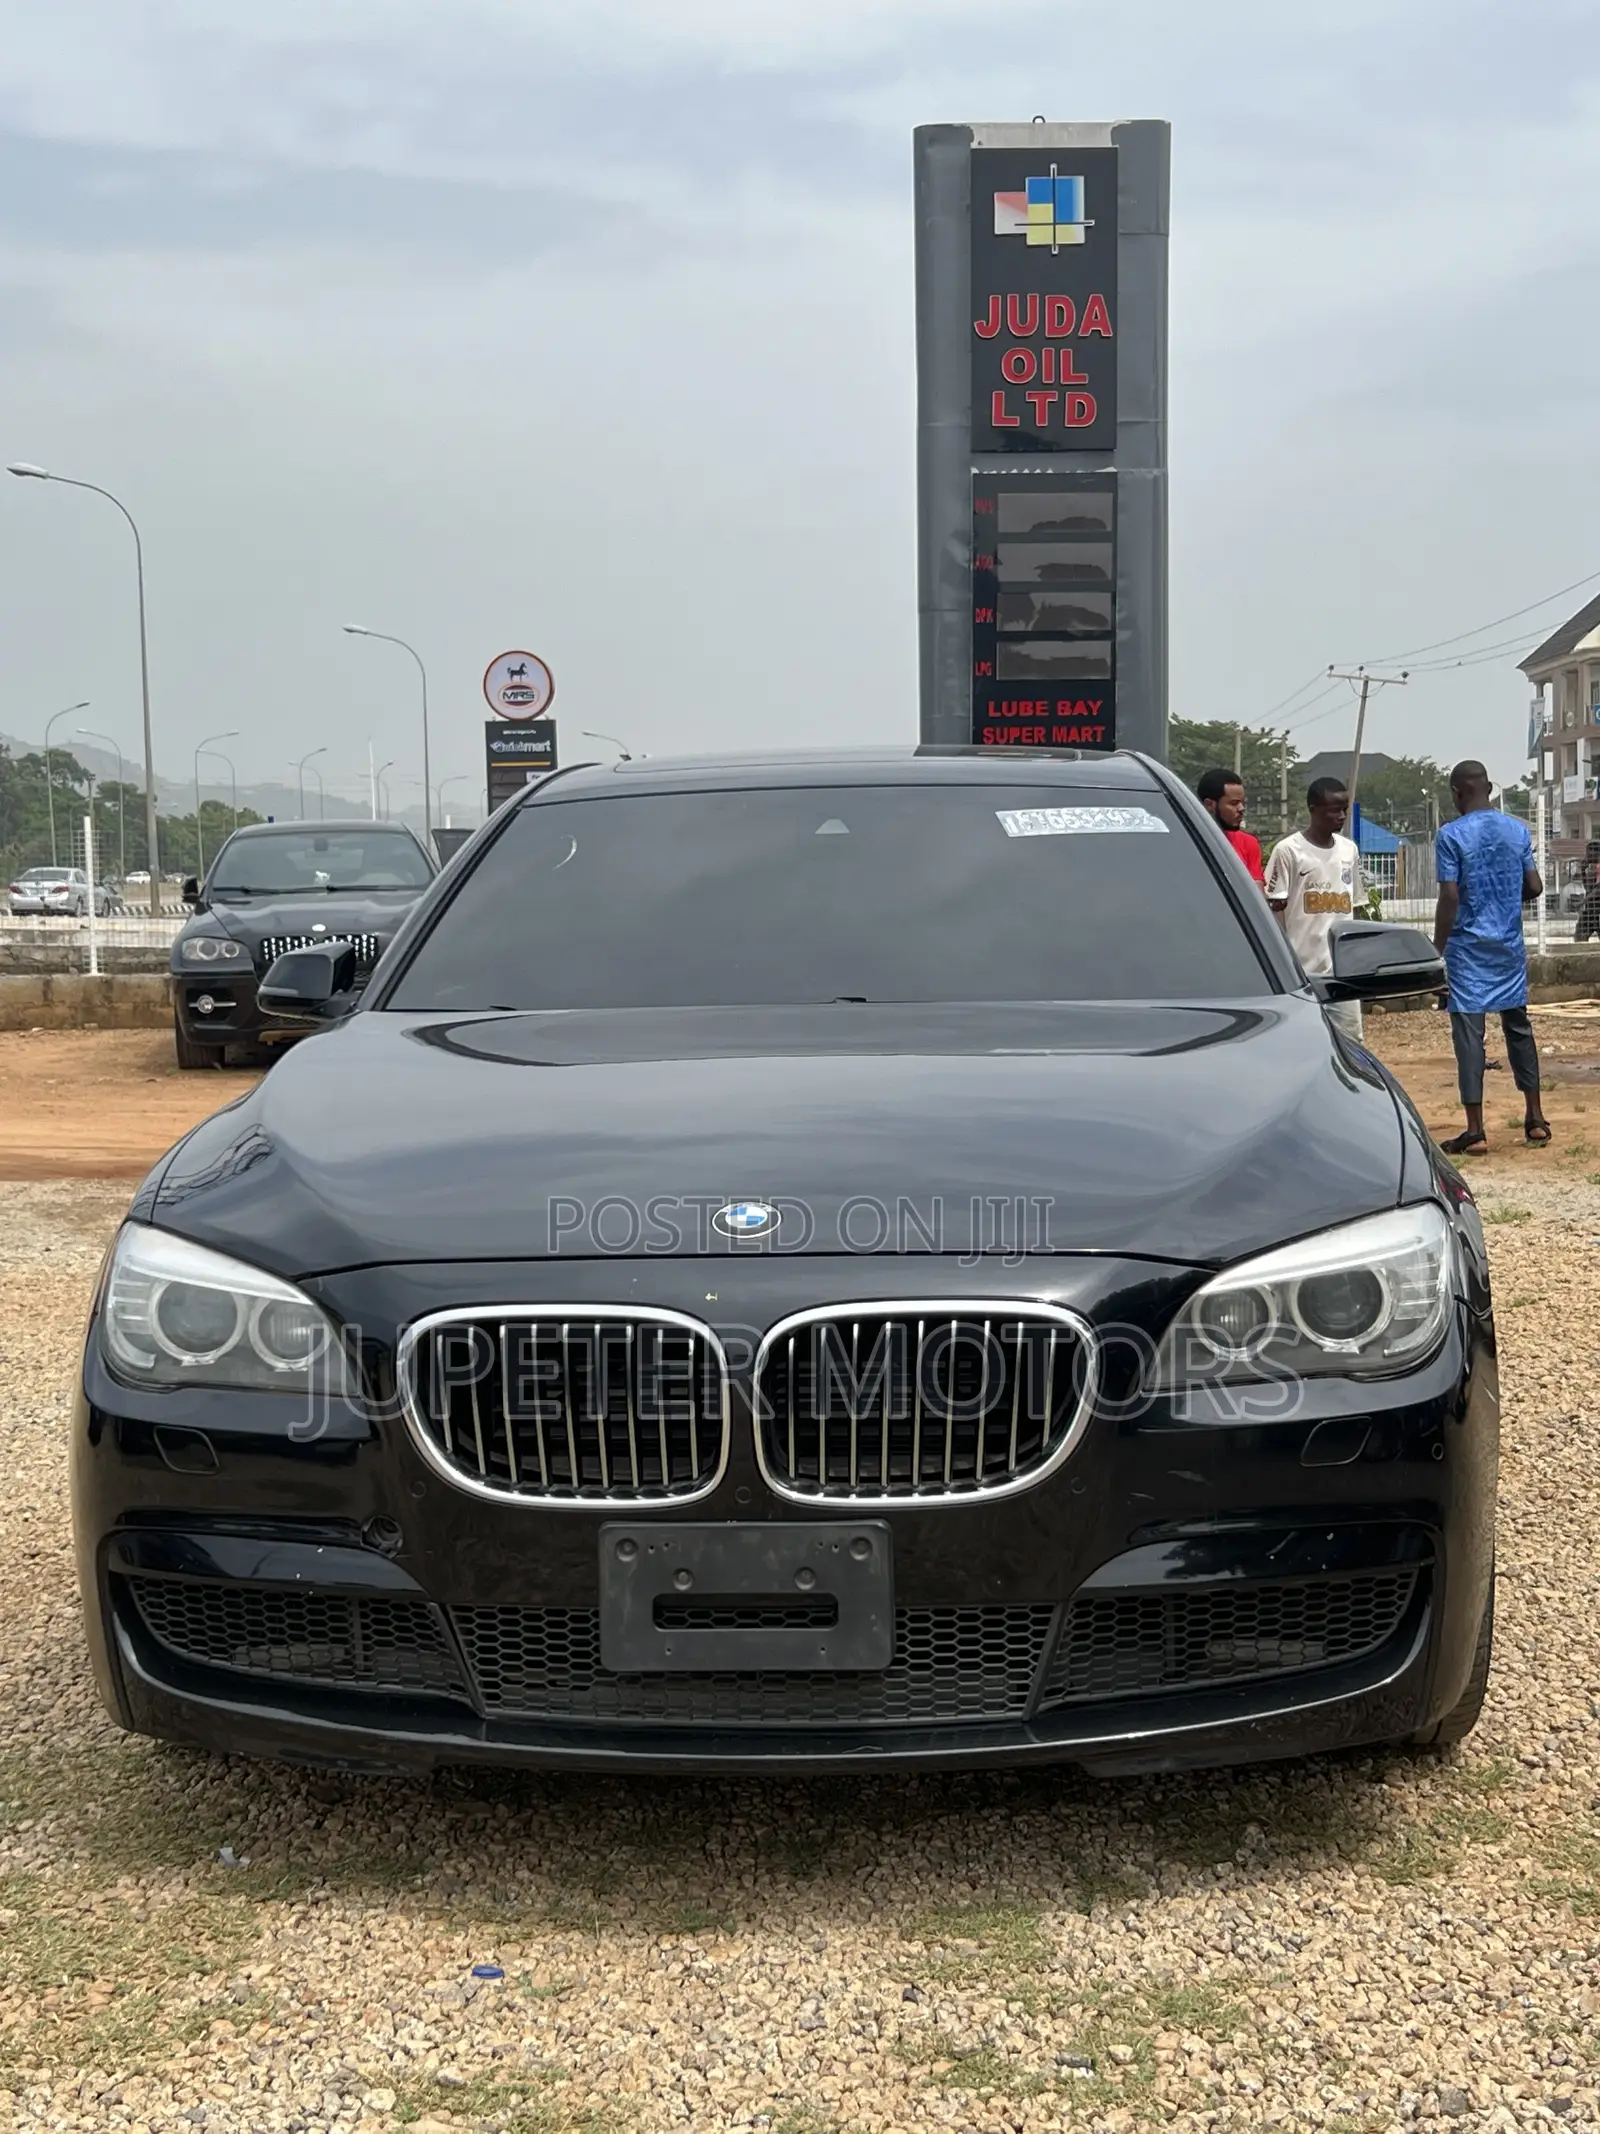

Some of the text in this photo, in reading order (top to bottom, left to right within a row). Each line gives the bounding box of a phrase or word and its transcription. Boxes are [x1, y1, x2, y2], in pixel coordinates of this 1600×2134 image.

[974, 294, 1113, 338] JUDA
[1001, 348, 1089, 384] OIL
[991, 391, 1097, 428] LTD
[502, 690, 535, 701] MRS
[987, 700, 1103, 717] LUBE BAY
[982, 725, 1106, 745] SUPER MART
